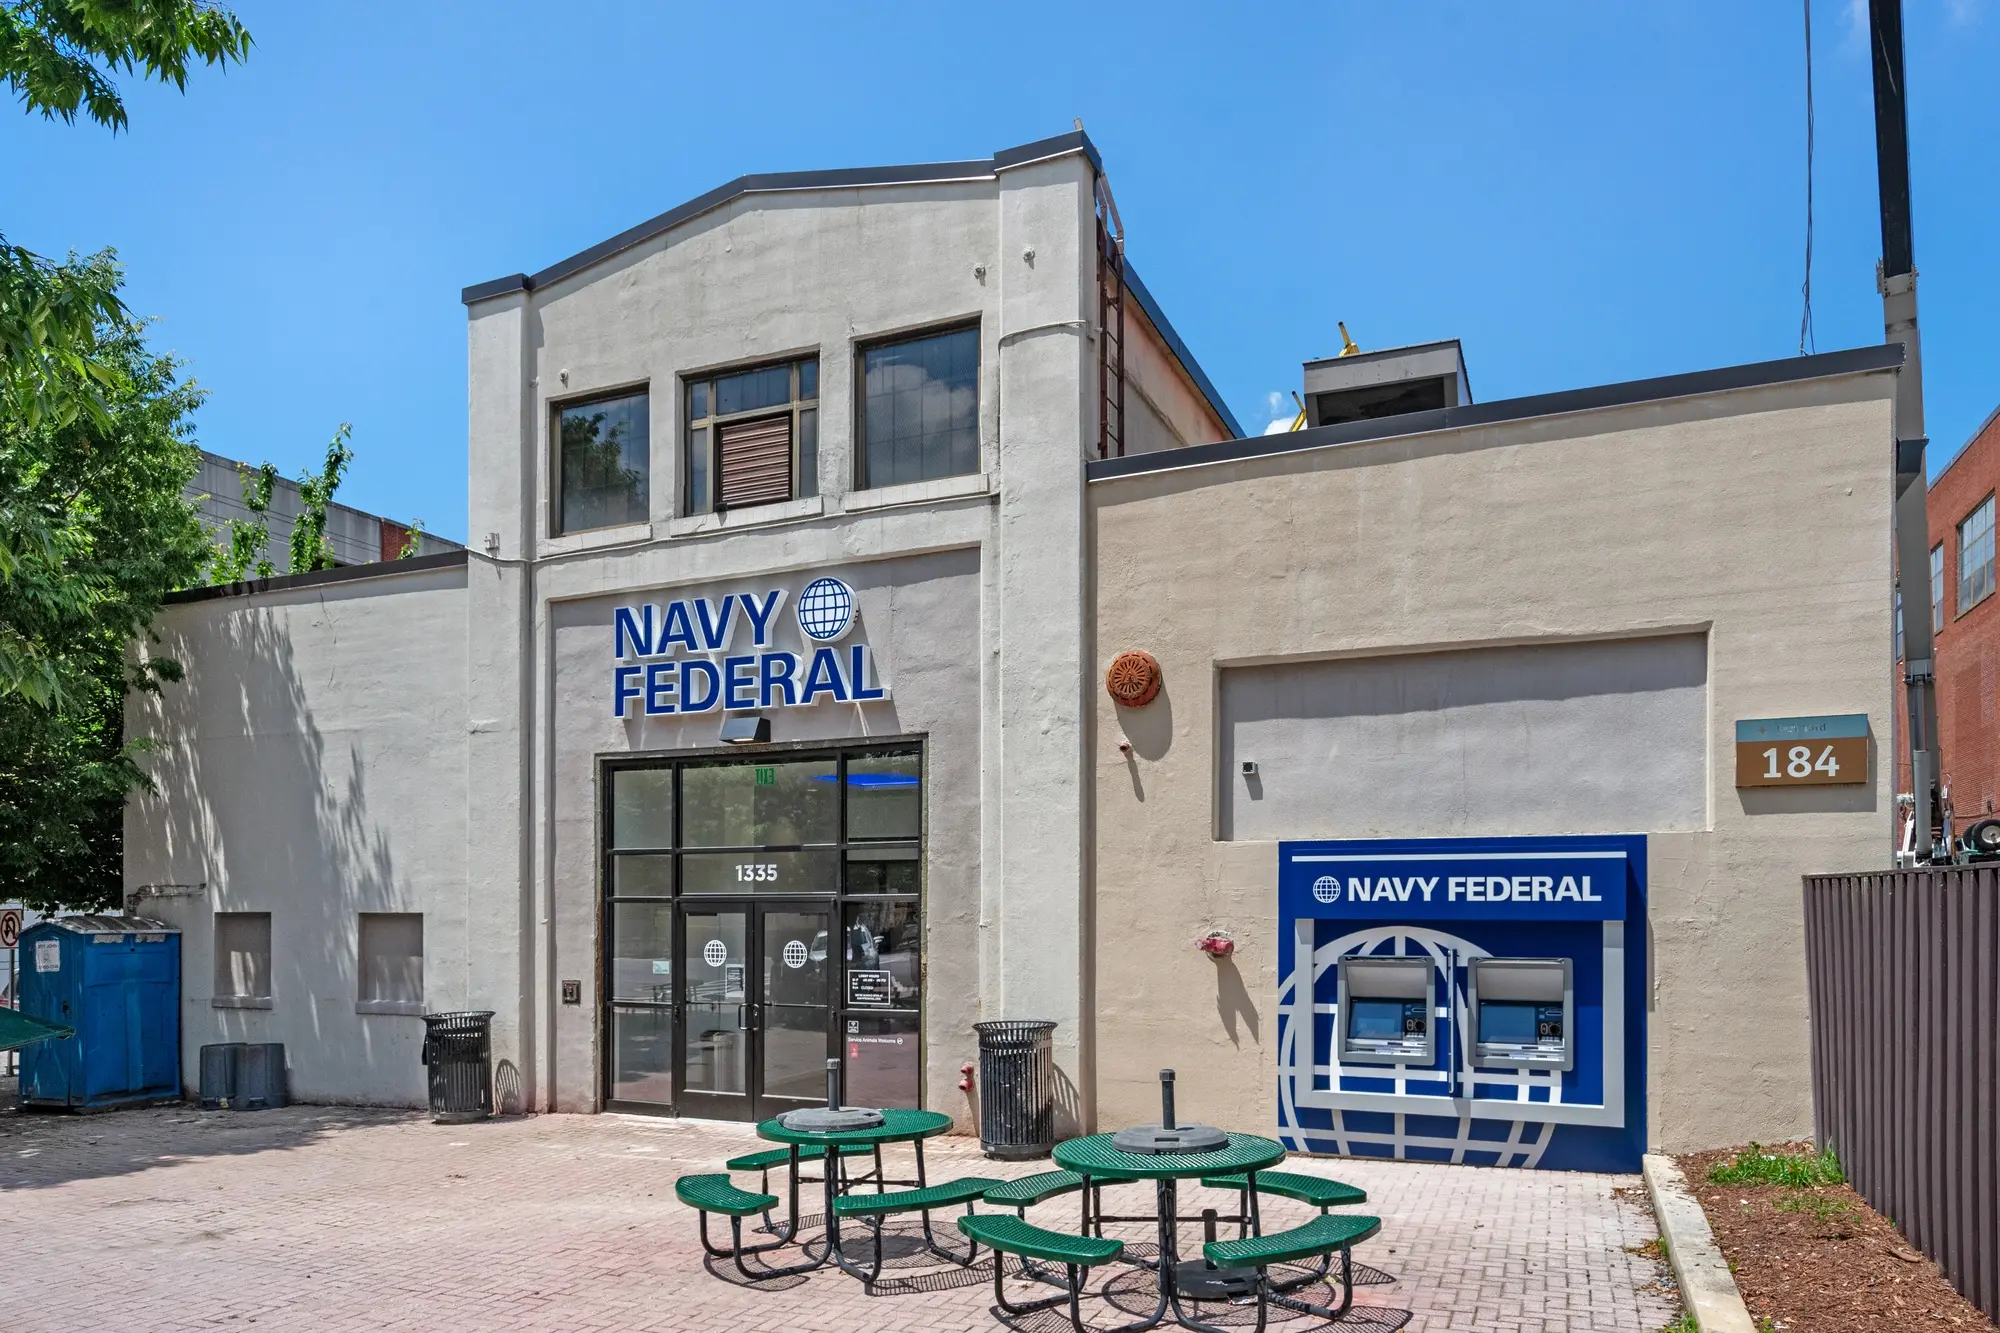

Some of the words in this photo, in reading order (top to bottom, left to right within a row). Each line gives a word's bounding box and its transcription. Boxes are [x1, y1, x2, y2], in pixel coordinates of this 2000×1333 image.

[613, 587, 788, 662] NAVY
[613, 644, 892, 720] FEDERAL
[1762, 745, 1840, 779] 184
[735, 864, 778, 883] 1335
[1348, 875, 1440, 903] NAVY
[1447, 875, 1602, 902] FEDERAL
